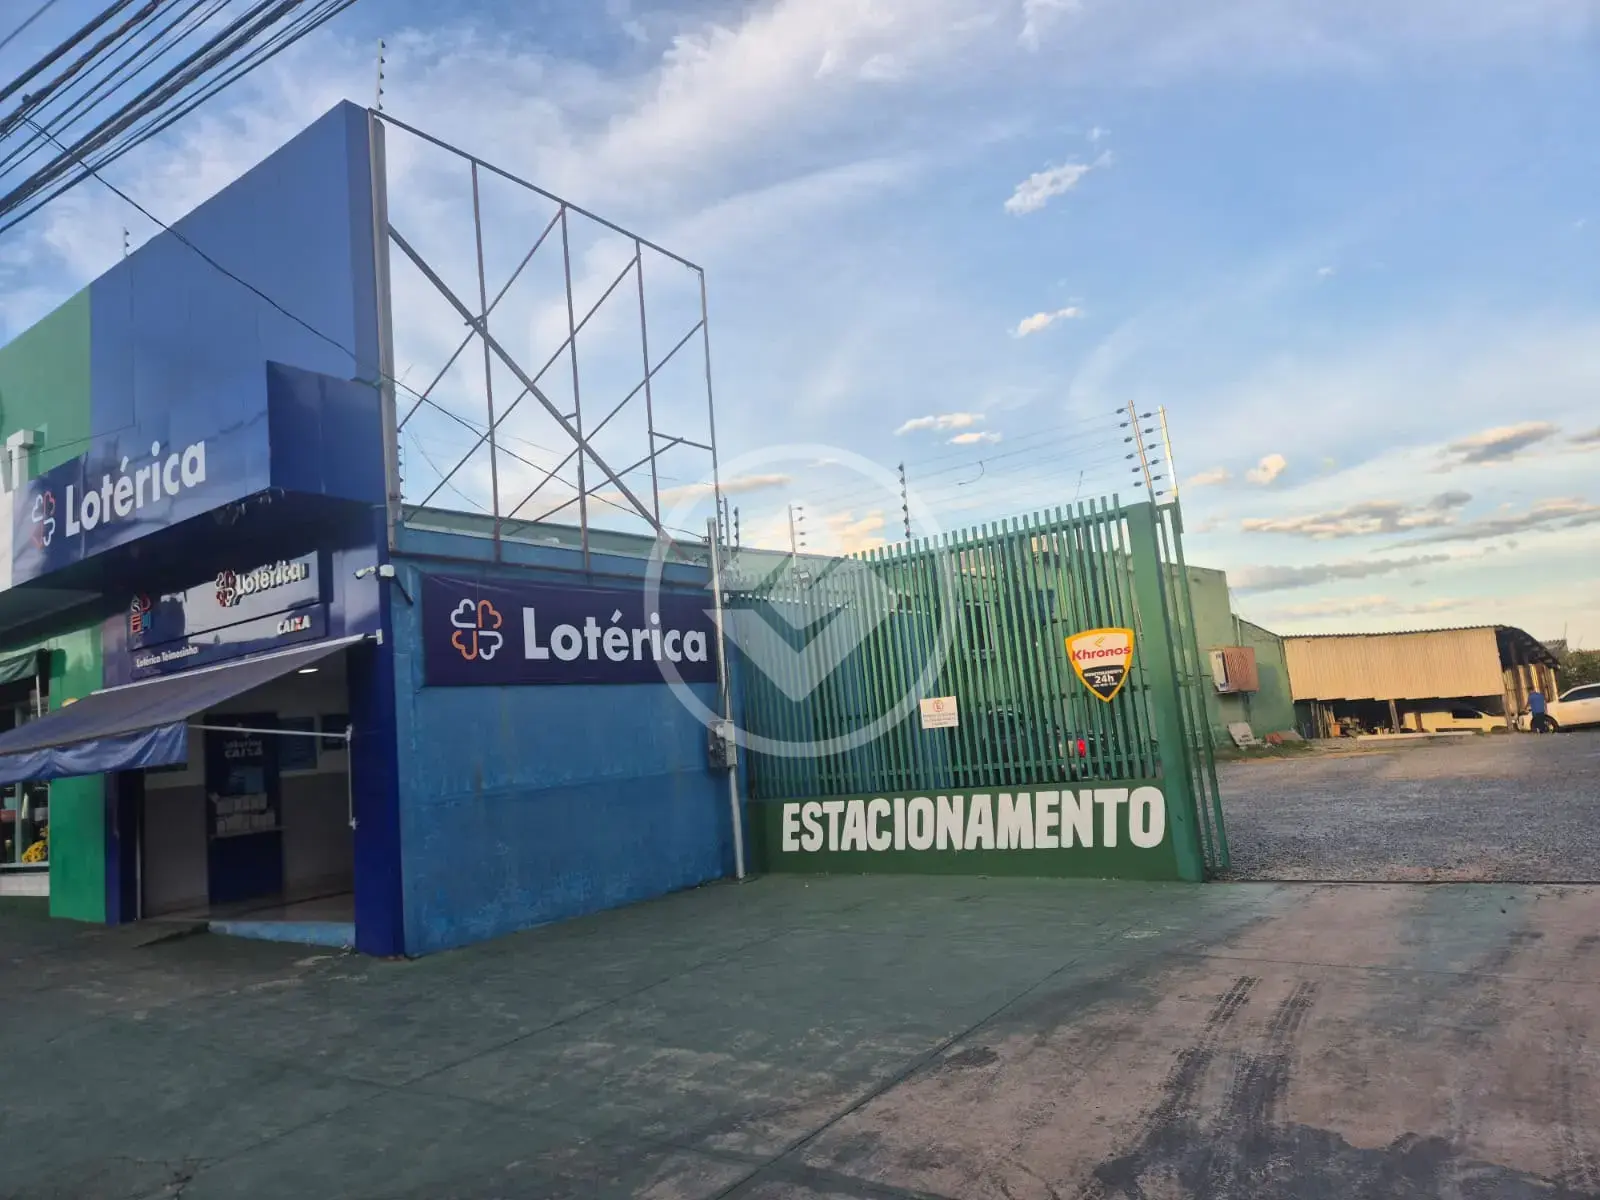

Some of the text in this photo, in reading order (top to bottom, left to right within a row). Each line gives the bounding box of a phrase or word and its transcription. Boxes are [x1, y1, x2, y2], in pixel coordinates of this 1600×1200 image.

[65, 441, 206, 537] Lotérica
[235, 560, 306, 596] Lotérica
[277, 615, 310, 635] CAIXA
[522, 607, 707, 662] Lotérica
[136, 655, 161, 667] Lotérica
[1072, 646, 1132, 661] Khronos
[1094, 673, 1114, 684] 24h
[782, 786, 1166, 852] ESTACIONAMENTO
